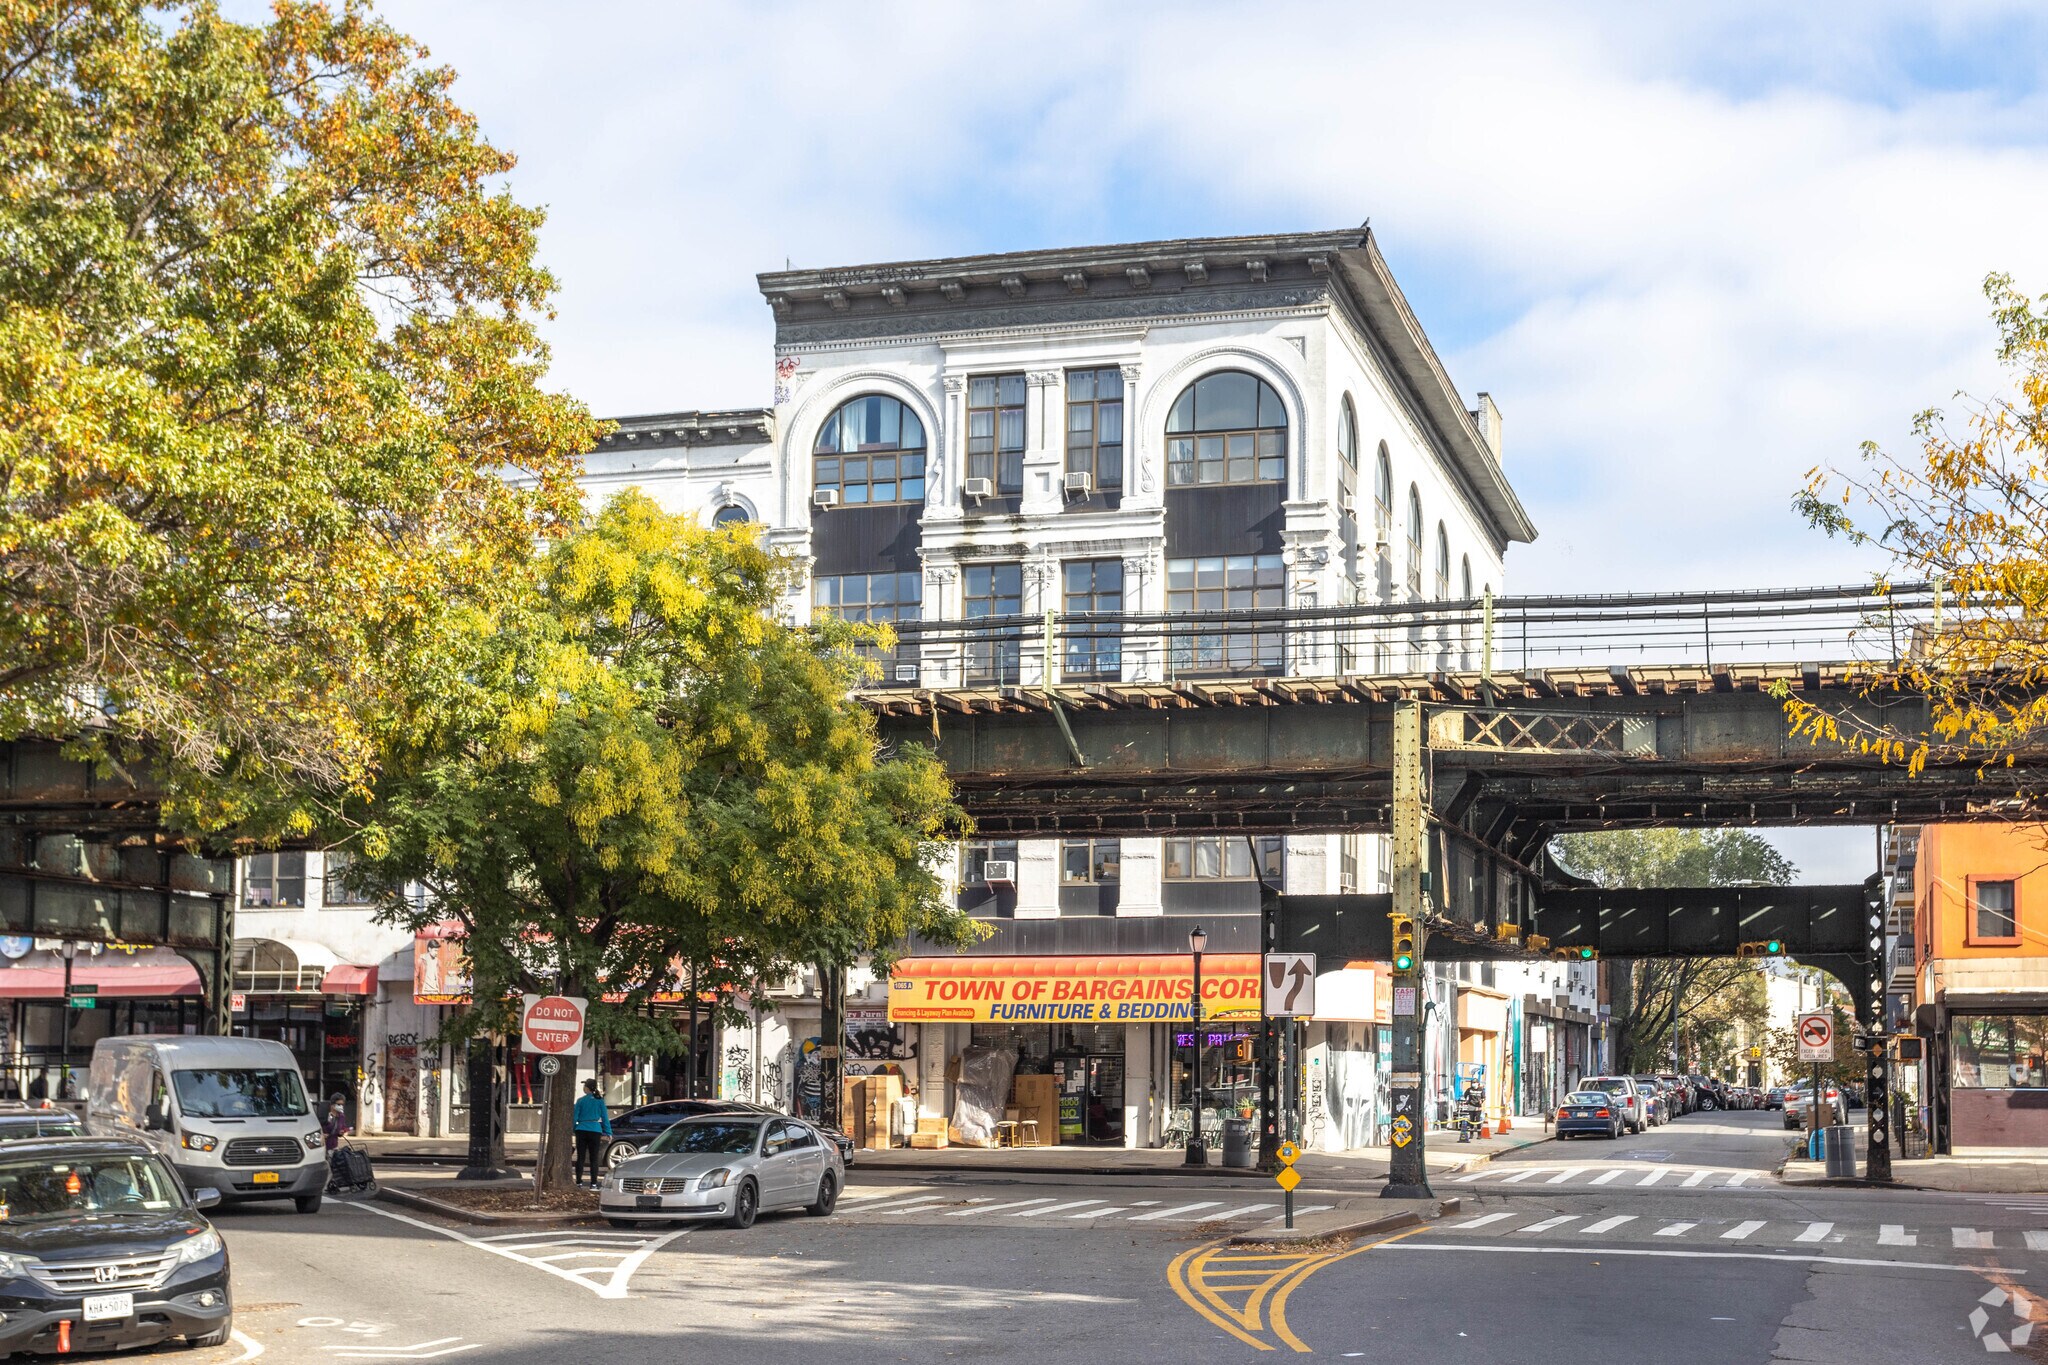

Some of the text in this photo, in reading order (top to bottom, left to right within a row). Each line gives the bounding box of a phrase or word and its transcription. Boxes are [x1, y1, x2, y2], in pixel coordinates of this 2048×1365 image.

[924, 978, 1261, 1000] TOWN OF BARGAINS COR
[536, 1007, 573, 1017] DO NOT
[893, 1009, 916, 1017] Financing
[921, 1009, 940, 1018] Layaway
[990, 1003, 1095, 1019] FURNITURE
[1098, 1003, 1112, 1019] &
[536, 1032, 569, 1043] ENTER
[1237, 1044, 1243, 1057] 6
